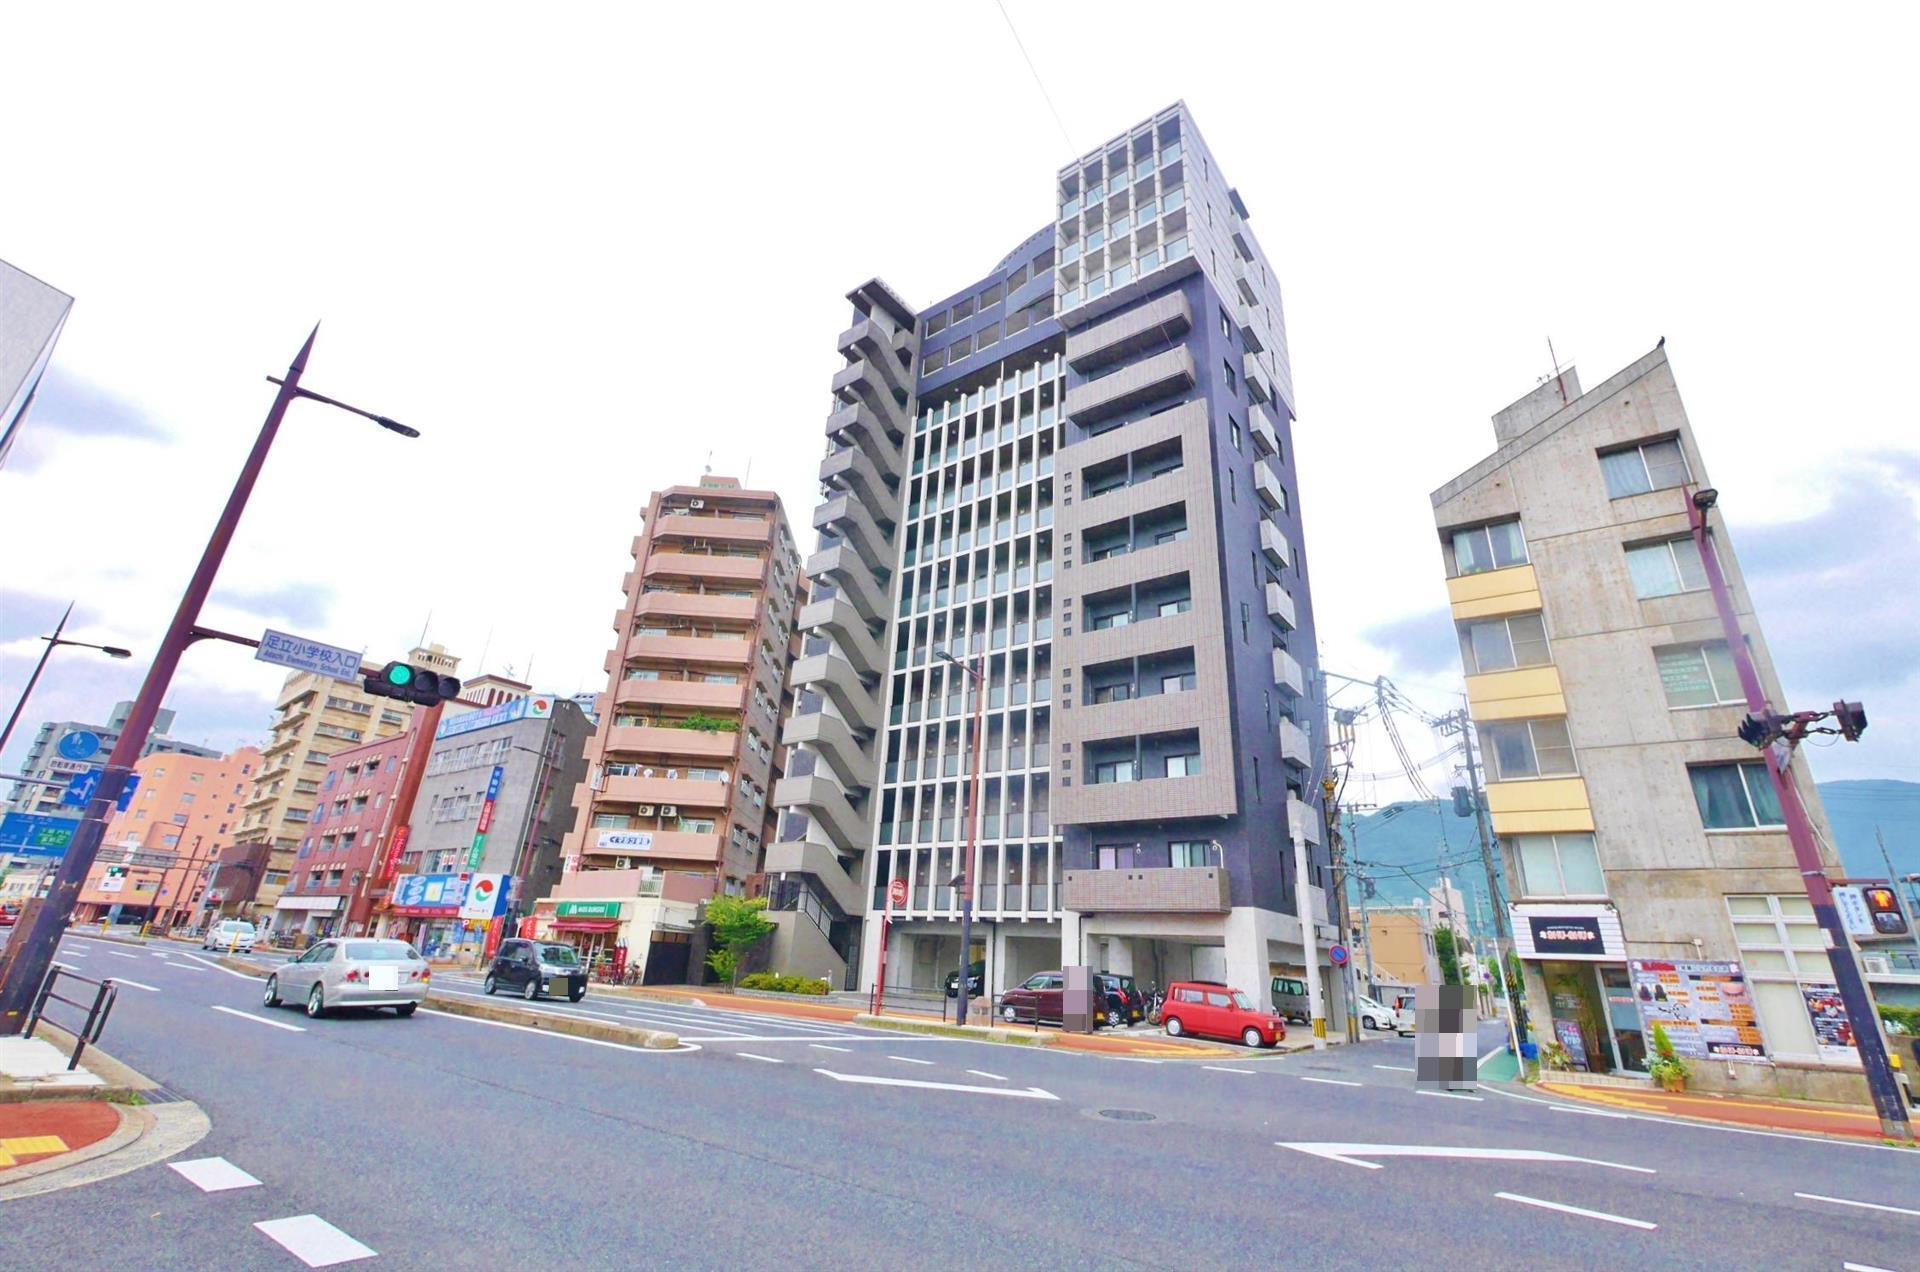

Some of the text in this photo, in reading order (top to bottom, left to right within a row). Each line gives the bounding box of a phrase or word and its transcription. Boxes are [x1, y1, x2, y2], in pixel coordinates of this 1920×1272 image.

[264, 634, 358, 669] 足立小学校入口
